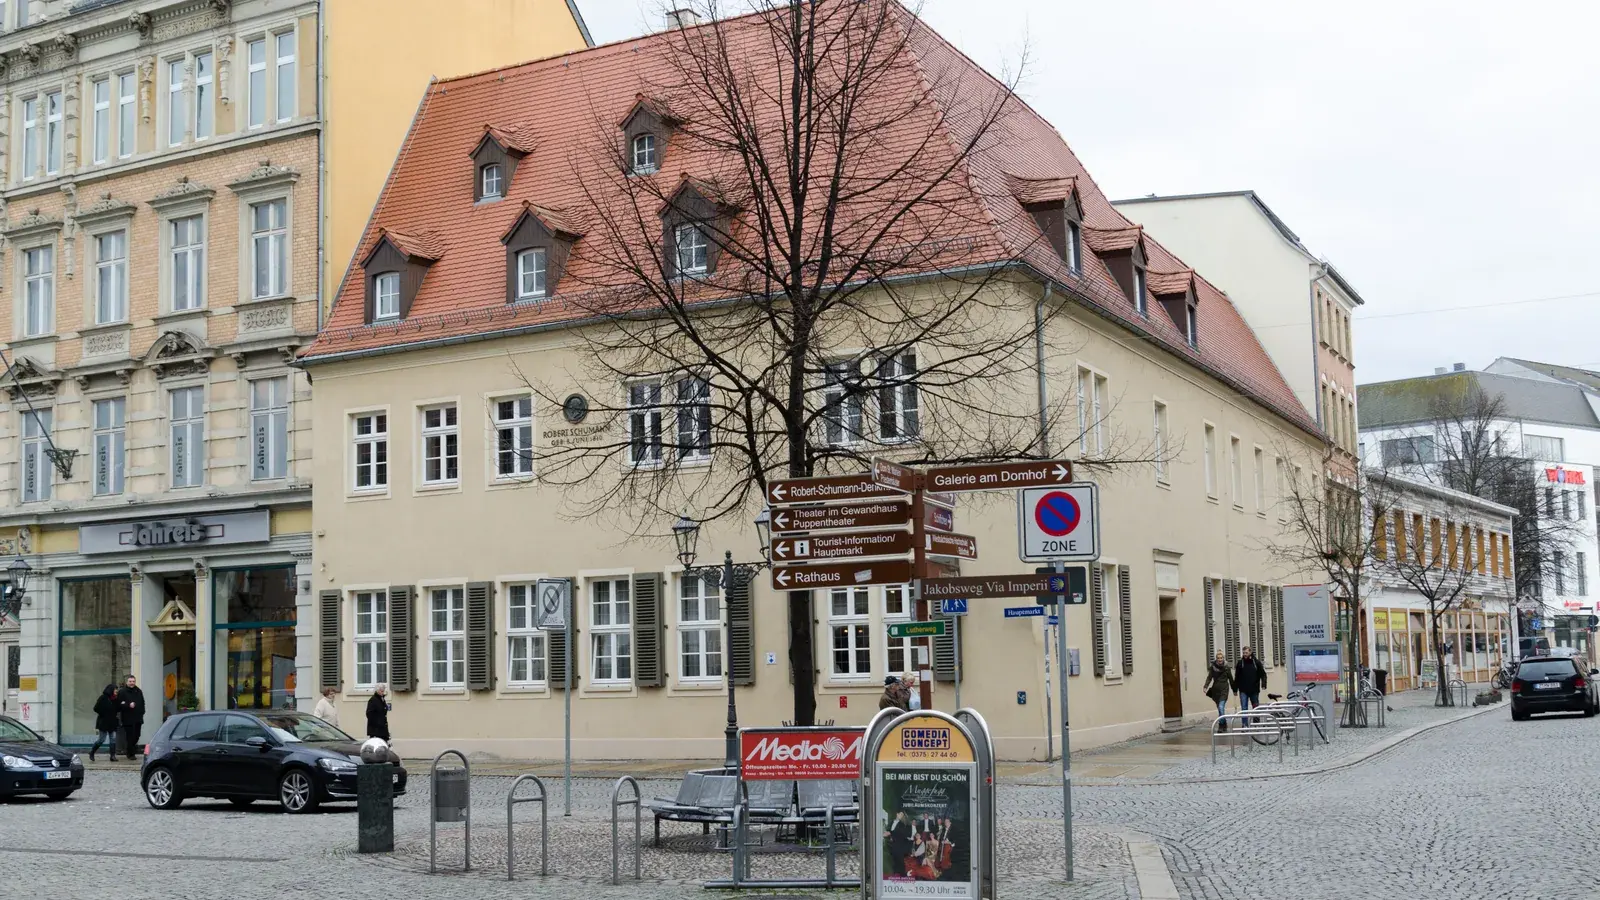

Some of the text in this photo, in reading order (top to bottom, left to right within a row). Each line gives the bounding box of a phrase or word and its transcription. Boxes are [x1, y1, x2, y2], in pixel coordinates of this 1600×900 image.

[543, 428, 568, 438] ROBERT
[935, 468, 1048, 486] Galerie am Domhof
[791, 482, 890, 497] Robert-Schumann-Denk
[794, 504, 898, 518] Theater im Gewandhaus
[794, 518, 856, 529] Puppentheater
[130, 518, 207, 547] Jahreis
[814, 534, 896, 547] Tourist-Information/
[1042, 540, 1076, 552] ZONE
[814, 546, 863, 558] Hauptmarkt
[795, 572, 840, 582] Rathaus
[924, 580, 1048, 596] Jakobsweg Via Imperii
[1008, 608, 1040, 616] Hauptmarkt
[906, 626, 936, 634] Lutherweg
[904, 730, 947, 738] COMEDIA
[904, 739, 947, 748] CONCEPT
[942, 773, 966, 781] SCHÖN
